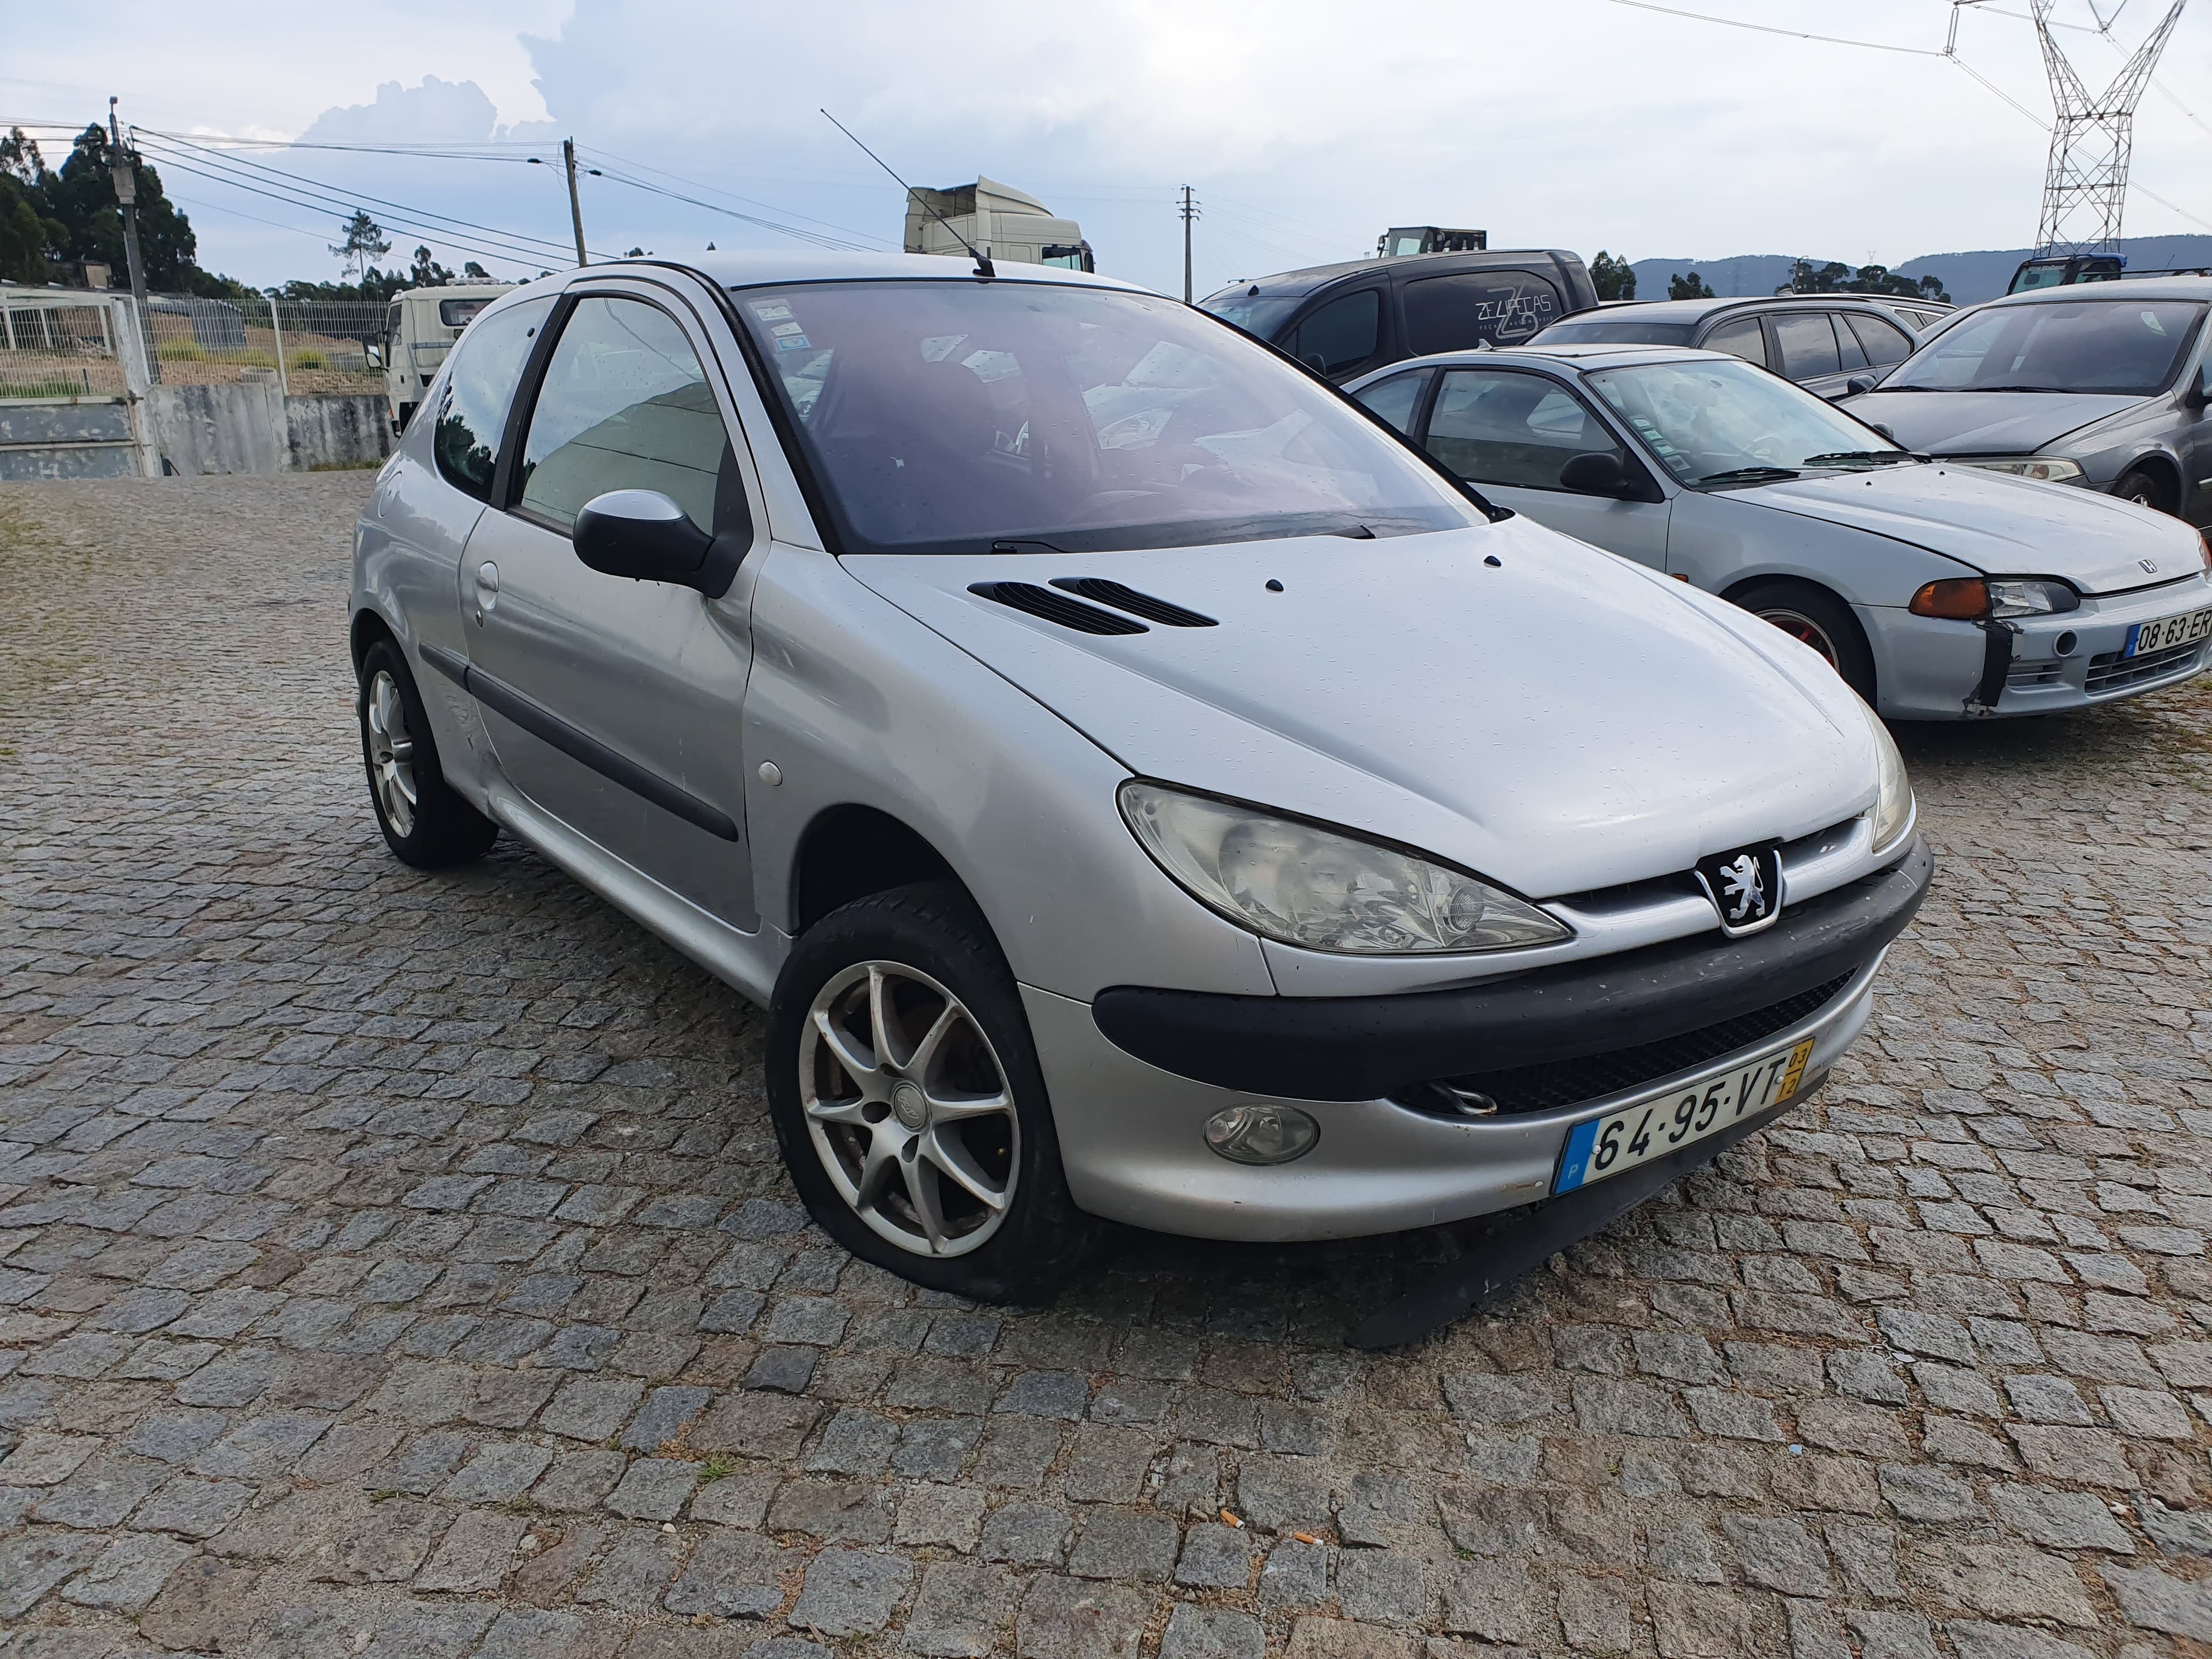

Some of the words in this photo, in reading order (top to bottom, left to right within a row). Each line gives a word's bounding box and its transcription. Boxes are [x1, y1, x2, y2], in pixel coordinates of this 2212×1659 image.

[1788, 1048, 1806, 1069] 03
[1778, 1083, 1796, 1098] 12
[1567, 1164, 1579, 1180] P
